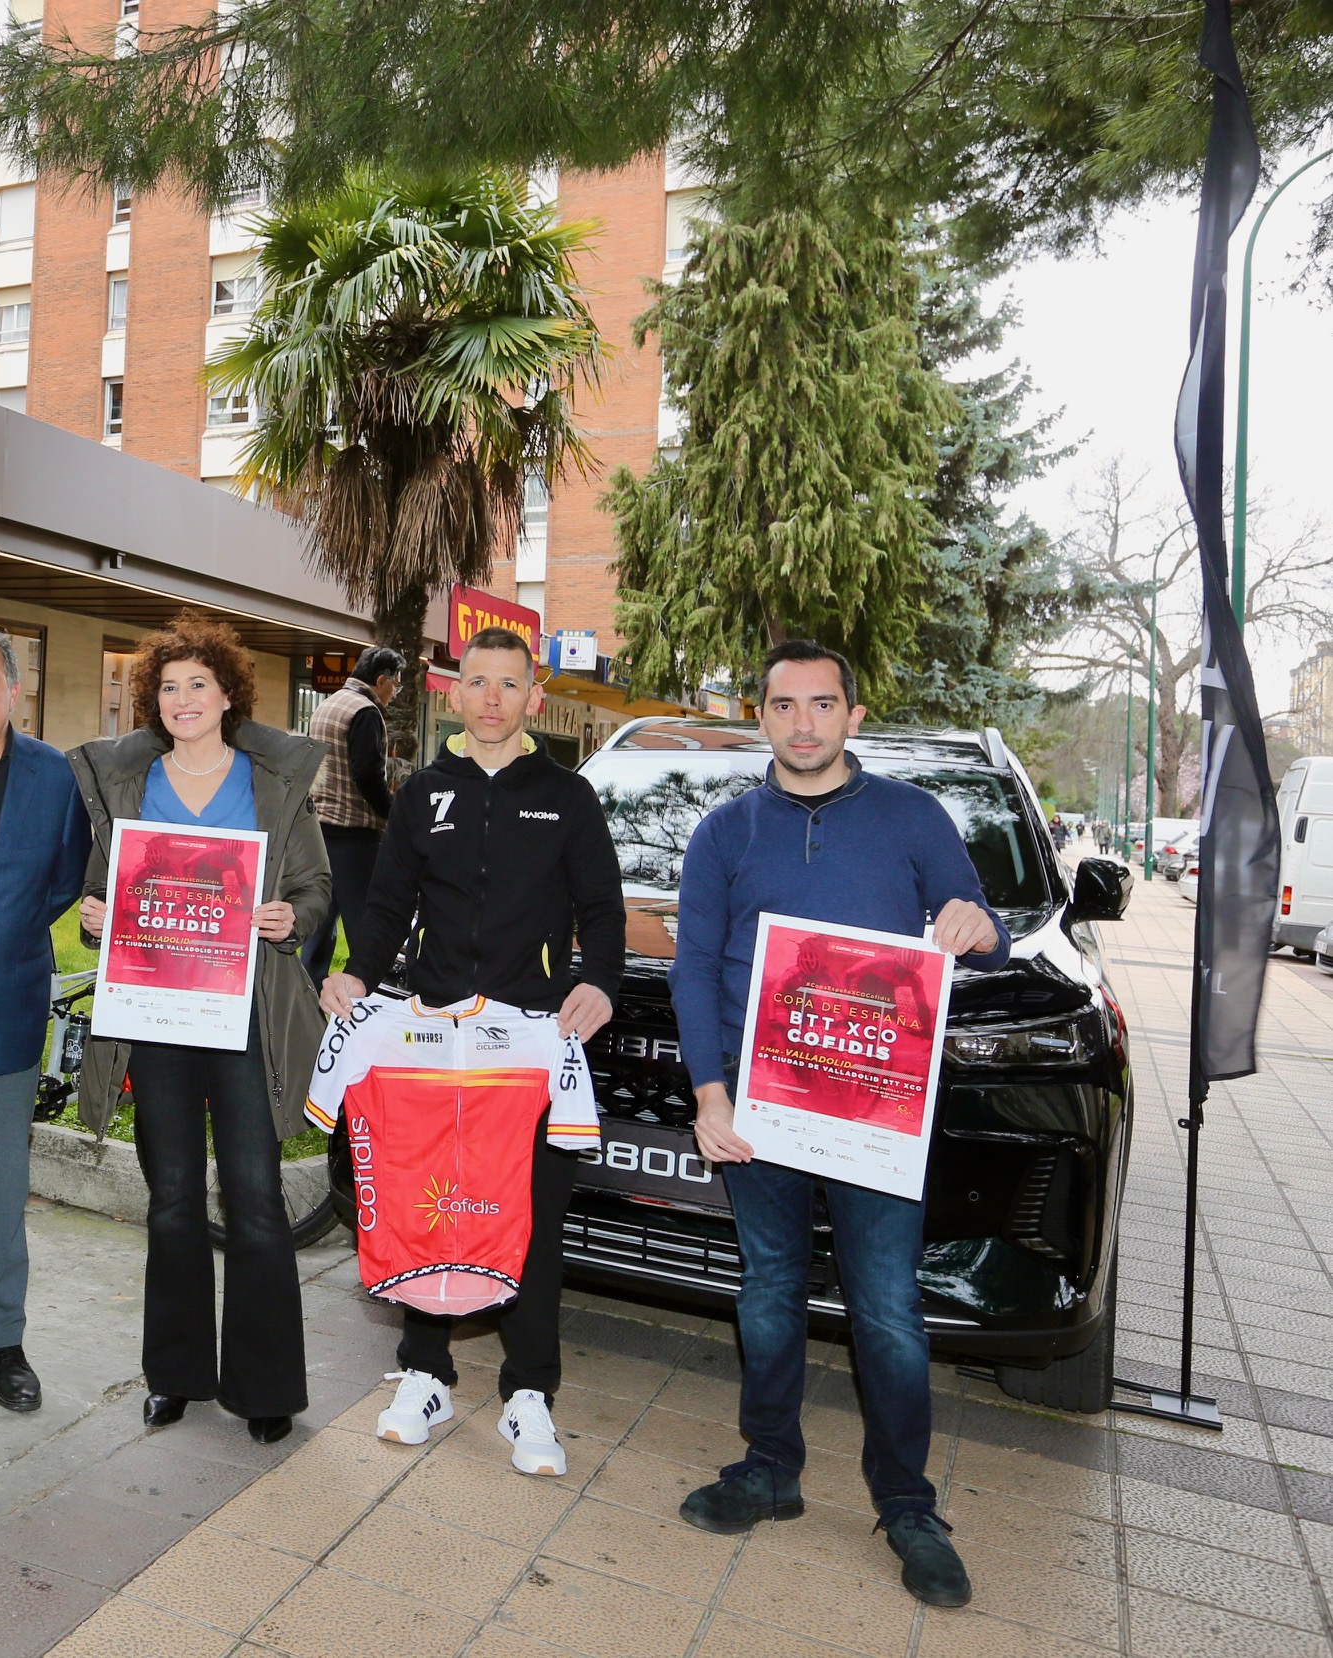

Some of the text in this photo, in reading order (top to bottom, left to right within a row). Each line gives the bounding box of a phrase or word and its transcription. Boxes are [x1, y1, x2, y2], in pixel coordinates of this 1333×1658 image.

[316, 675, 347, 684] TABAC
[429, 790, 456, 823] 7
[126, 886, 243, 905] COPA DE ESPAÑA
[139, 899, 225, 919] BTT XCO
[137, 914, 221, 934] COFIDIS
[125, 940, 153, 949] CIUDAD
[166, 944, 212, 954] VALLADOLID
[136, 933, 190, 945] VALLADOLID
[773, 992, 920, 1029] COPA DE ESPAÑA
[789, 1010, 898, 1044] BTT XCO
[787, 1028, 891, 1061] COFIDIS
[765, 1046, 780, 1055] MAR
[785, 1048, 852, 1068] VALLADOLID
[757, 1052, 923, 1092] GP CIUDAD DE VALLADOLID BTT XCO
[351, 1116, 377, 1232] Cofidis
[436, 1196, 501, 1216] Cofidis
